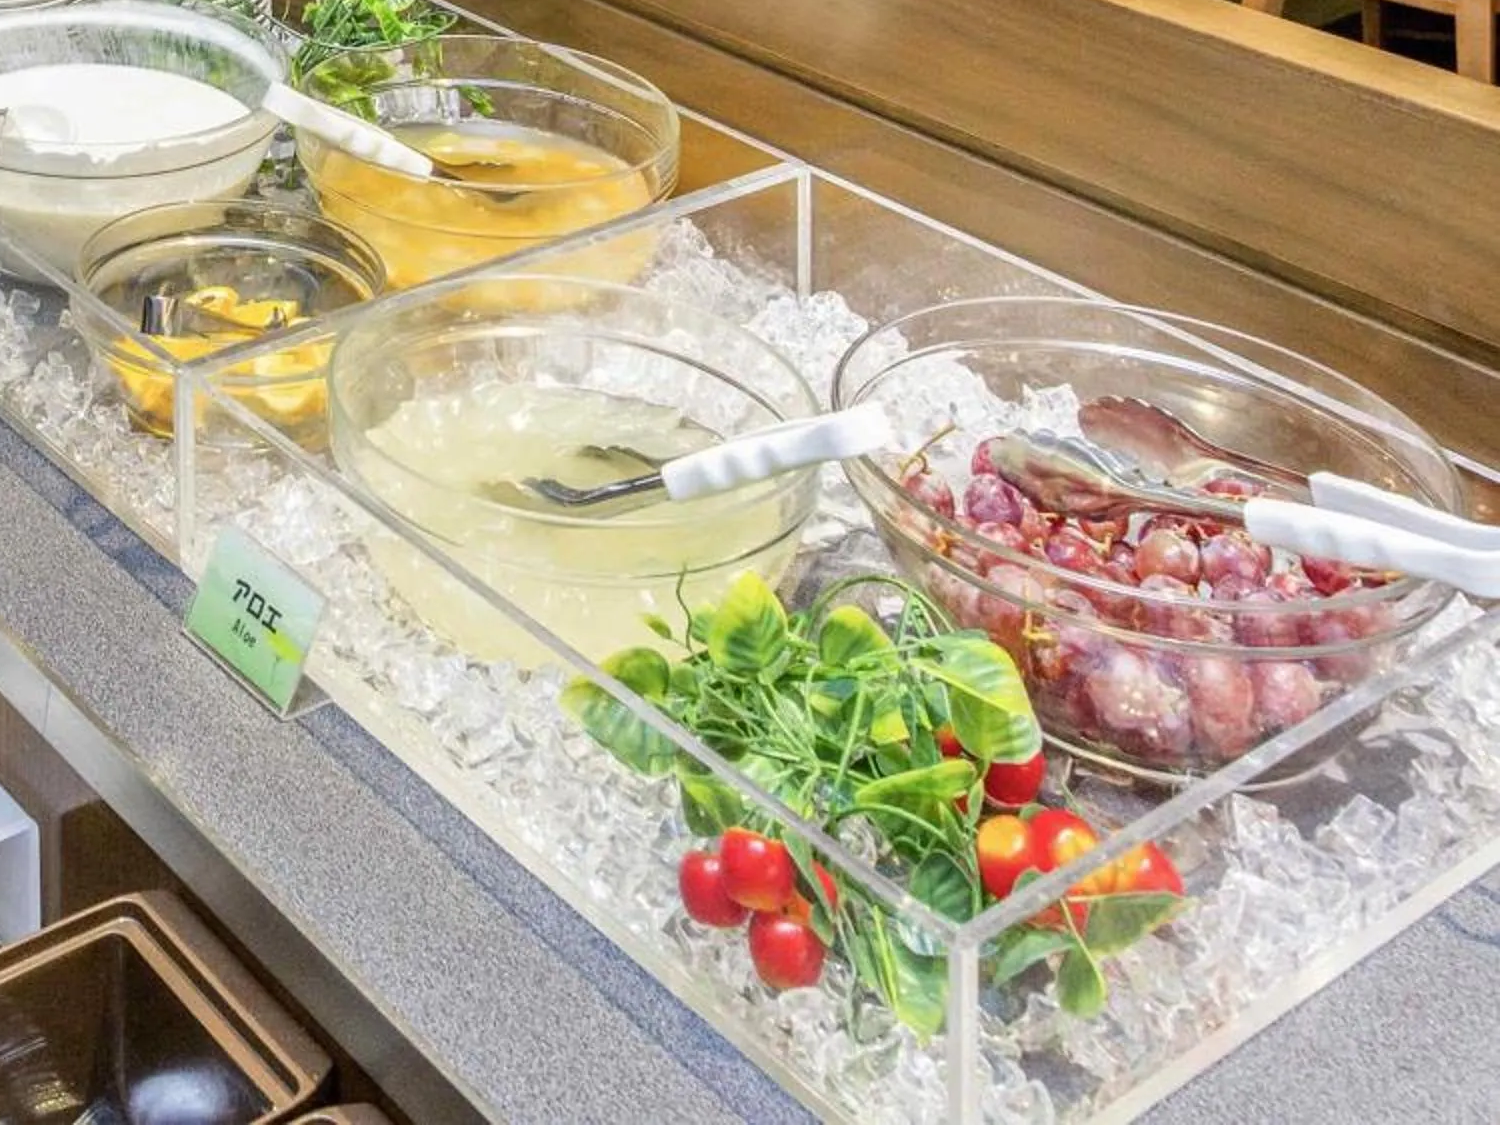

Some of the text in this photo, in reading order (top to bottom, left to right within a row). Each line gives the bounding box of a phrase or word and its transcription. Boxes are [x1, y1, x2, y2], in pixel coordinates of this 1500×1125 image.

[232, 578, 283, 634] アロエ
[231, 618, 257, 648] Aloe
